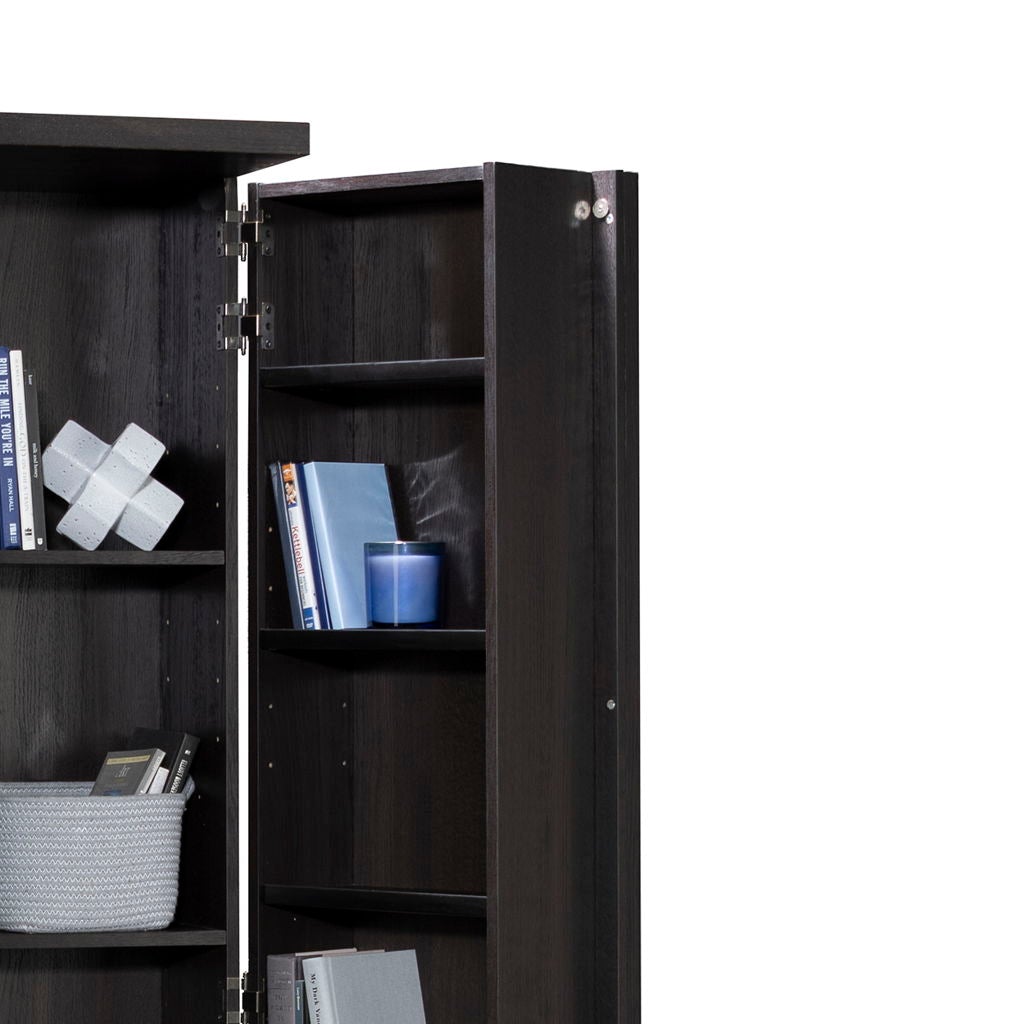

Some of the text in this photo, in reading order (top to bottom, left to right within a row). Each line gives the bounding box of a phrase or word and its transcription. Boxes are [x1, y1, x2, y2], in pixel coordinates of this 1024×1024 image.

[0, 397, 11, 420] MILE
[0, 421, 13, 458] YOU'RE
[2, 458, 14, 468] IN
[291, 526, 304, 576] Kettlebell
[310, 973, 316, 985] My
[312, 987, 320, 1006] Dark
